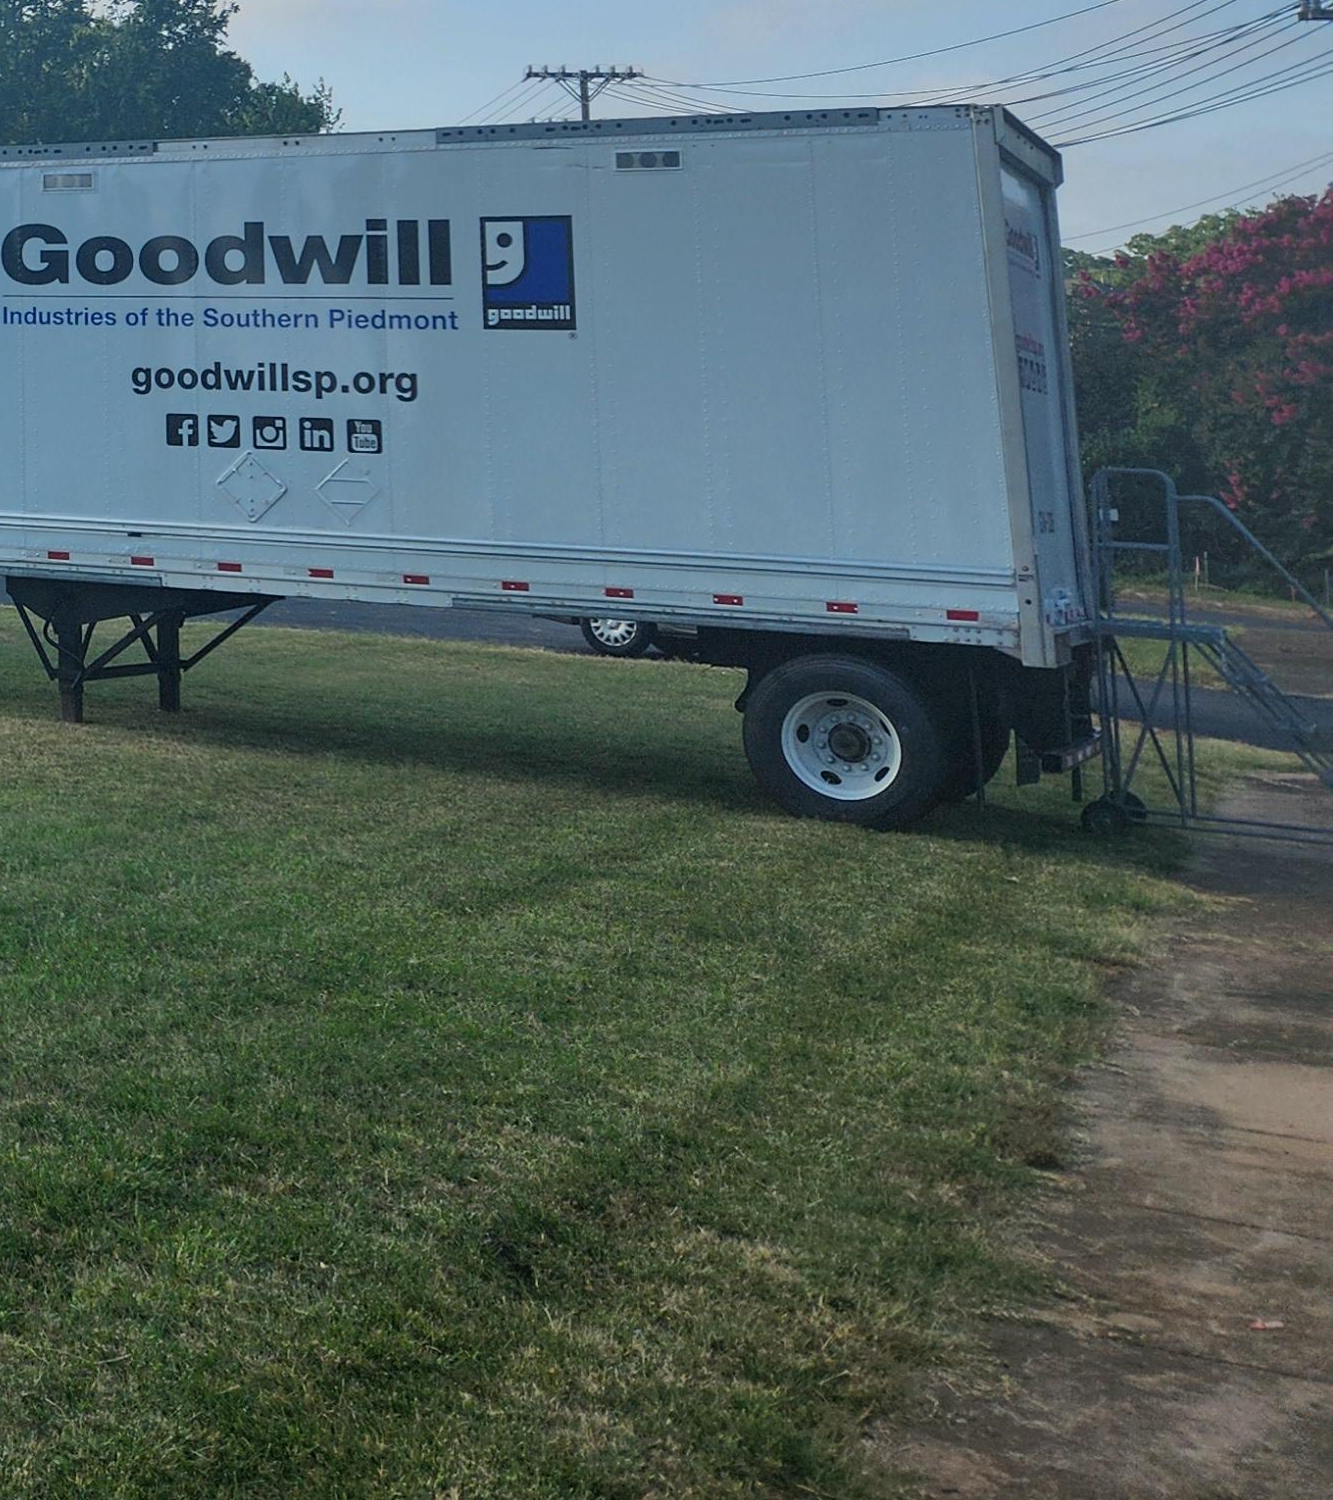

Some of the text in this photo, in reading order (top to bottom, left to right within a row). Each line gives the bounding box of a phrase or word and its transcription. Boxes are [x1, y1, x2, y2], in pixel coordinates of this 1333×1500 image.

[1, 219, 452, 285] Goodwill
[3, 306, 459, 330] Industries of the Southern Piedmont
[487, 304, 571, 326] goodwill
[131, 361, 419, 402] goodwillsp.org
